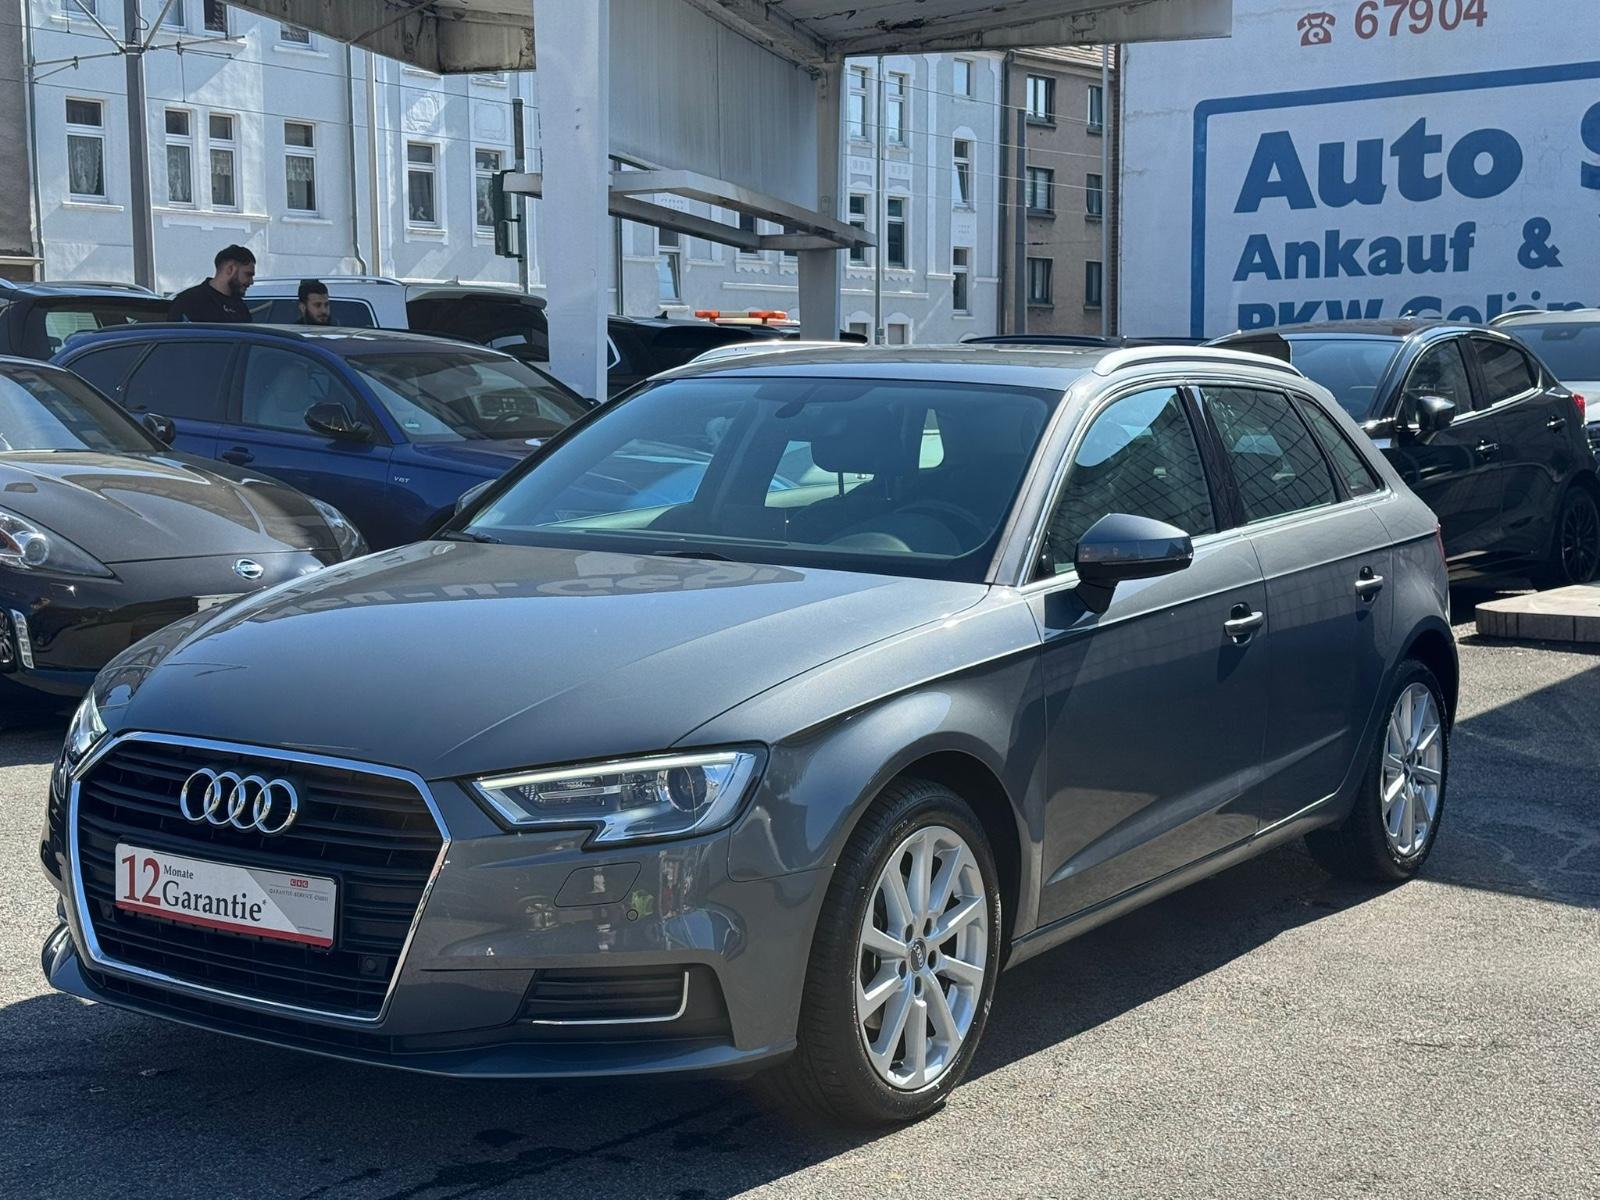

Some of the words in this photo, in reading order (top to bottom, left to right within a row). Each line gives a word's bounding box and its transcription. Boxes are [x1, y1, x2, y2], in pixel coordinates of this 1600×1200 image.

[1355, 0, 1488, 39] 67904
[1233, 117, 1523, 213] Auto
[1233, 221, 1476, 281] Ankauf
[1517, 217, 1563, 269] &
[121, 854, 161, 906] 12
[163, 864, 194, 880] Monate
